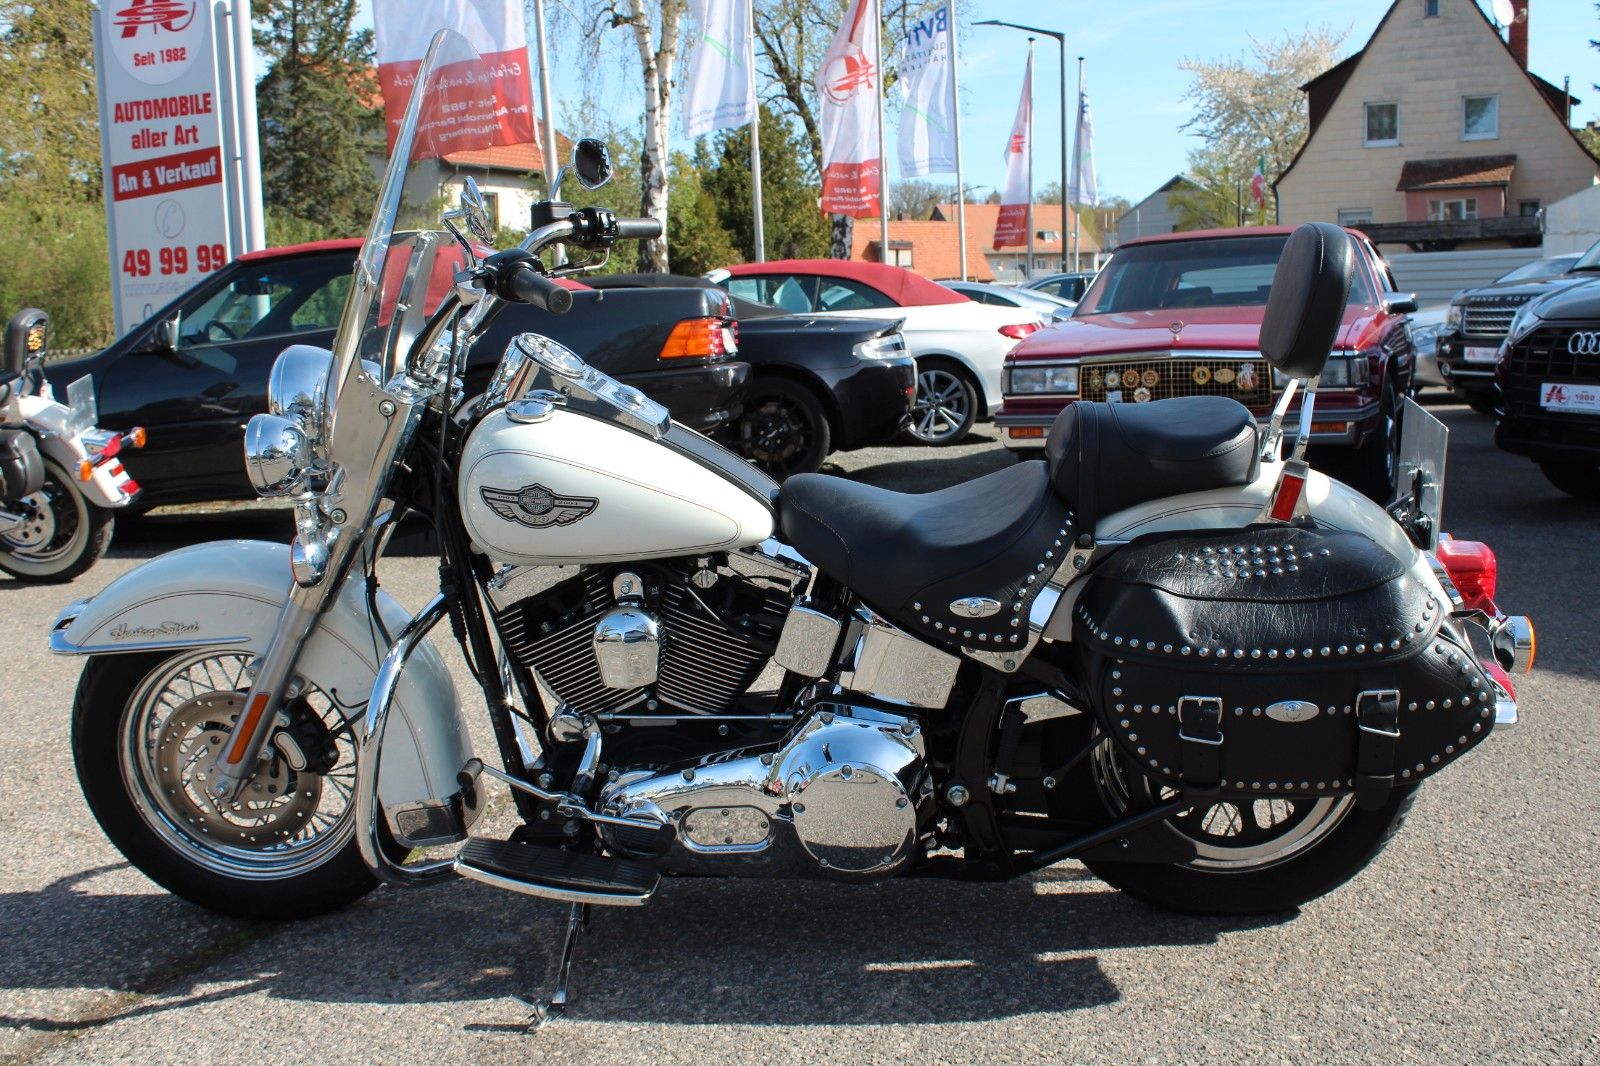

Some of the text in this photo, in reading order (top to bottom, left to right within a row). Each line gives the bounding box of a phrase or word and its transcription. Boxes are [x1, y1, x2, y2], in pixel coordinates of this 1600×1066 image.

[133, 47, 187, 67] Seit 1982
[113, 92, 212, 123] AUTOMOBILE
[131, 124, 199, 150] aller Art
[118, 155, 217, 193] An & Verkauf
[123, 243, 226, 277] 49 99 99
